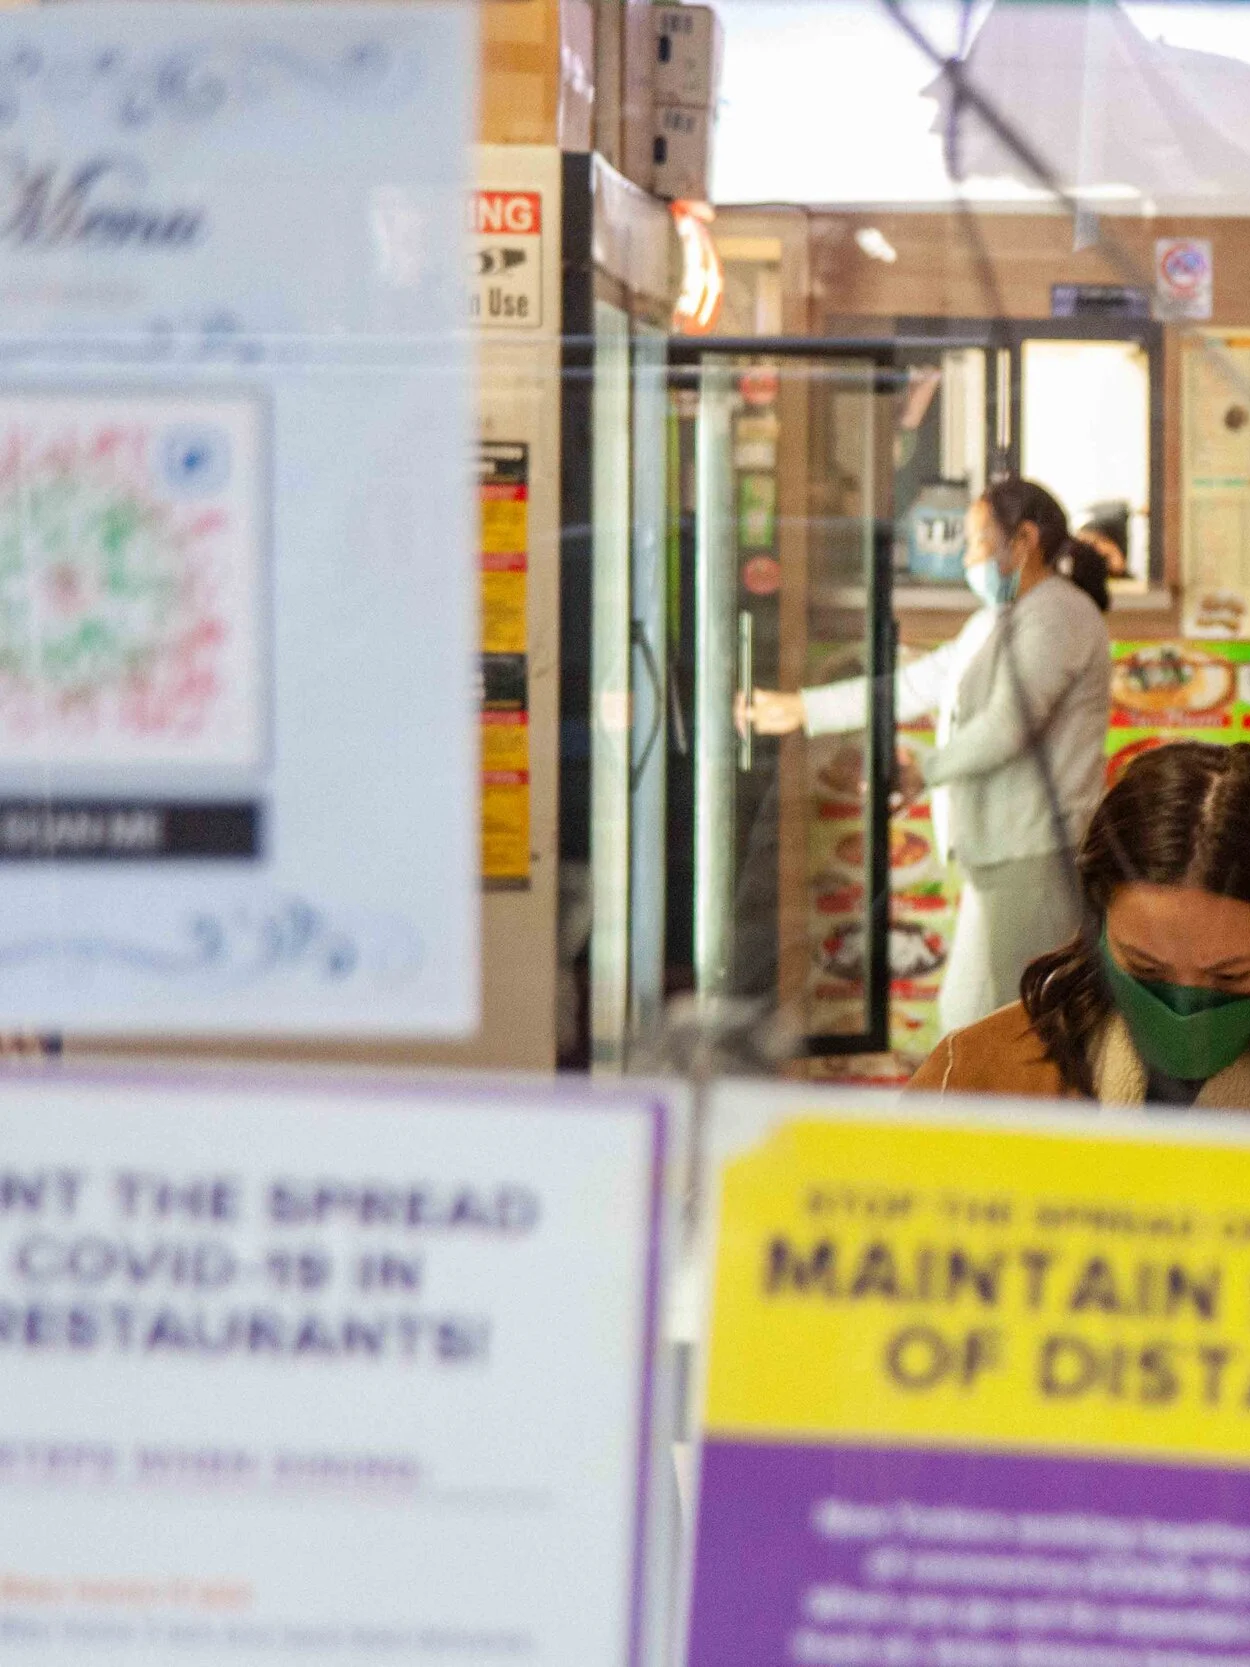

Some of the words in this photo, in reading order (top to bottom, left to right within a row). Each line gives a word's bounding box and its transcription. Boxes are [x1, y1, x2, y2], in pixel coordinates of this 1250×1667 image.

[489, 286, 529, 318] Use
[114, 1173, 236, 1224] THE
[266, 1179, 542, 1233] SPREAD
[15, 1235, 332, 1292] COVID-19
[354, 1250, 422, 1293] IN
[763, 1233, 1221, 1321] MAINTAIN
[883, 1325, 1003, 1394] OF
